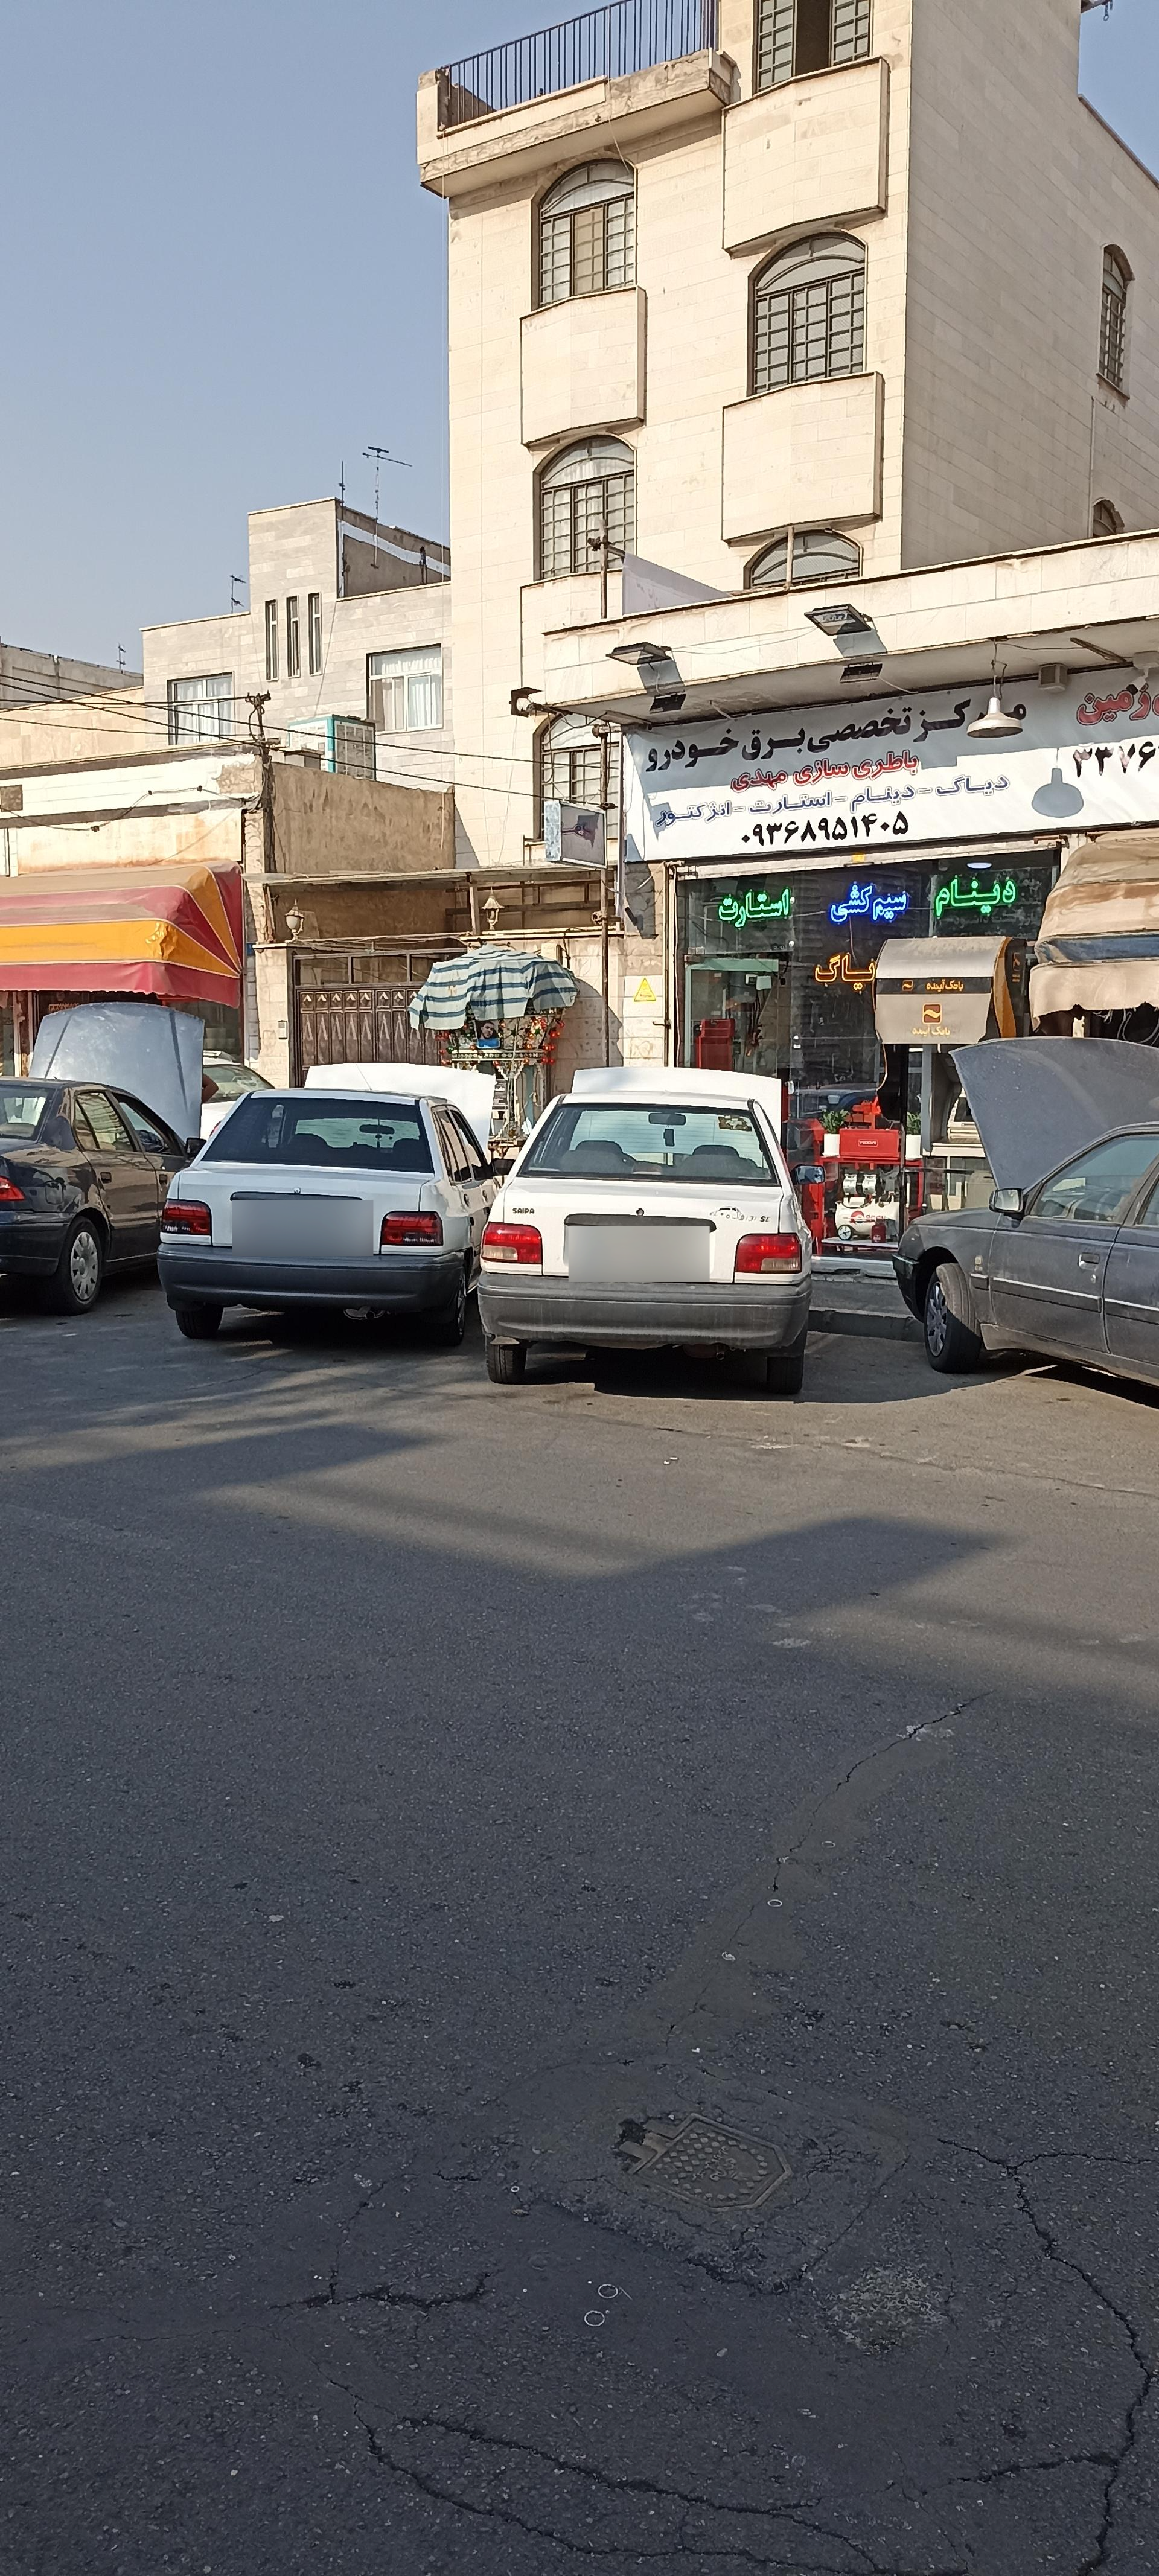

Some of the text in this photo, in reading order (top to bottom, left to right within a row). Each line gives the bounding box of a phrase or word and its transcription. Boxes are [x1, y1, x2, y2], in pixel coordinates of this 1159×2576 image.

[646, 698, 1026, 772] مکز تخصصی برق خودرو
[730, 750, 919, 792] باطری سازی مهدی
[1073, 741, 1159, 777] ۳۳۷۶
[749, 791, 832, 815] استارت
[850, 784, 916, 813] دینام
[936, 775, 1010, 797] دیاگ
[655, 801, 732, 828] انژکتور
[741, 811, 909, 846] ۰۹۳۶۸۹۵۱۴۰۵
[718, 888, 790, 928] استارت
[936, 878, 1016, 917] دینام
[815, 952, 876, 990] یاگ
[926, 978, 964, 992] بانک آینده
